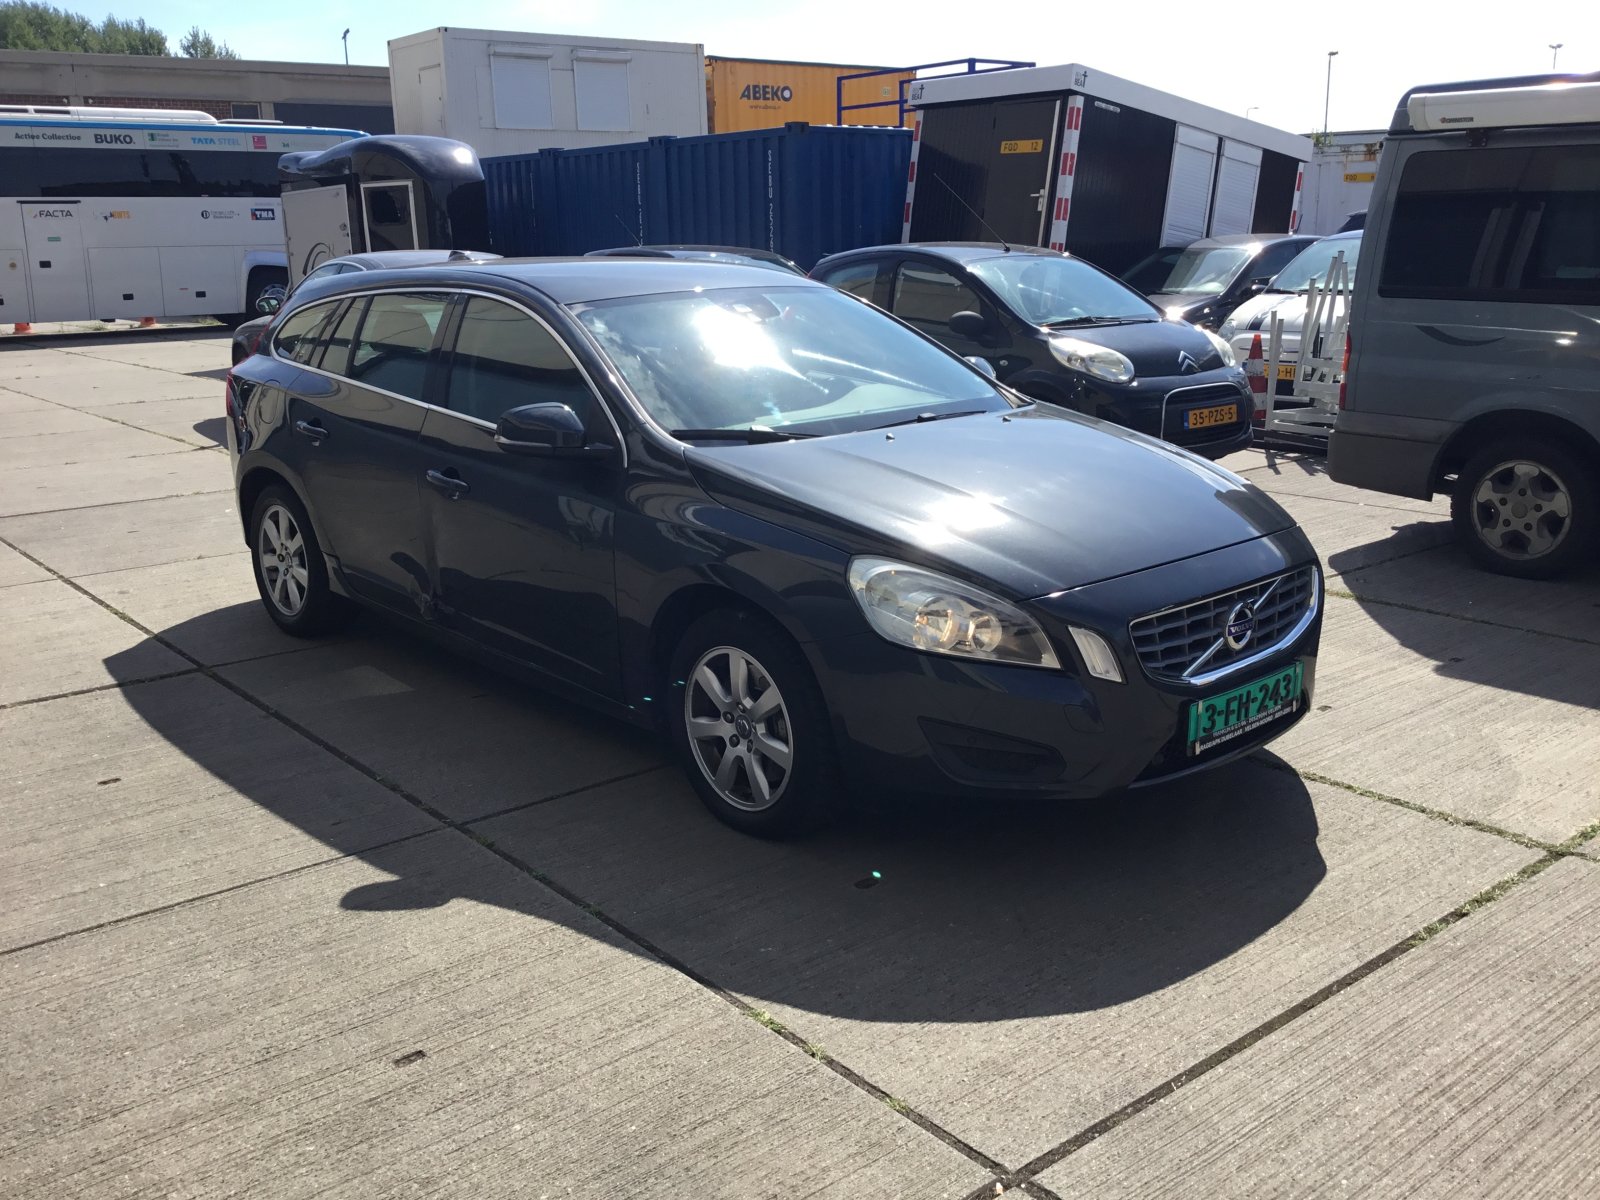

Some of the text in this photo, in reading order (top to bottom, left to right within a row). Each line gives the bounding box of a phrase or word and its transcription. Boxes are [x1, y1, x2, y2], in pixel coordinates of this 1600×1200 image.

[739, 84, 793, 102] ABEKO
[191, 137, 216, 145] TATA
[38, 209, 74, 218] FACTA
[1191, 407, 1234, 426] 35-PZS-5
[1202, 673, 1293, 735] 3-FH-243
